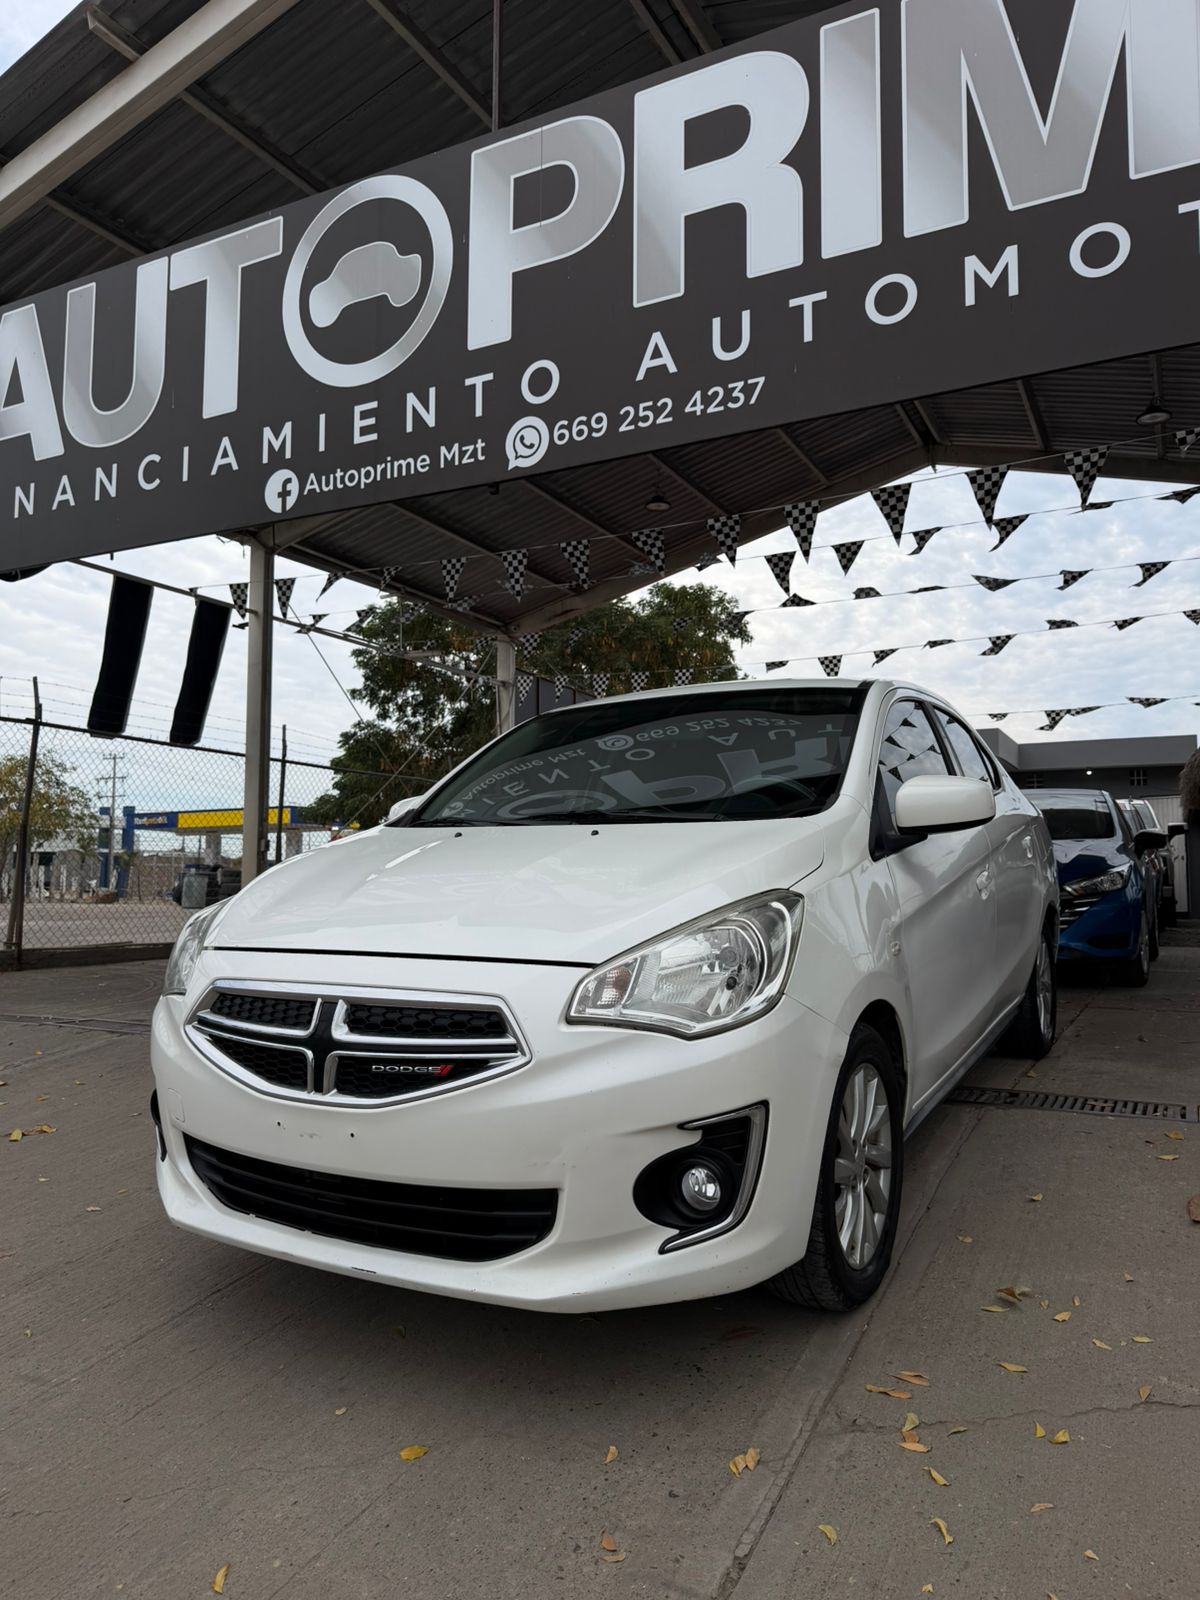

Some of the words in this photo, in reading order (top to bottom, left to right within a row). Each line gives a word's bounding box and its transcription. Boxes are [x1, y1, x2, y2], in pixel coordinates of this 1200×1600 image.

[553, 412, 607, 446] 669
[618, 398, 673, 433] 252
[684, 377, 766, 414] 4237
[303, 454, 430, 496] Autoprime
[439, 439, 486, 469] Mzt
[372, 1065, 441, 1073] DODGE
